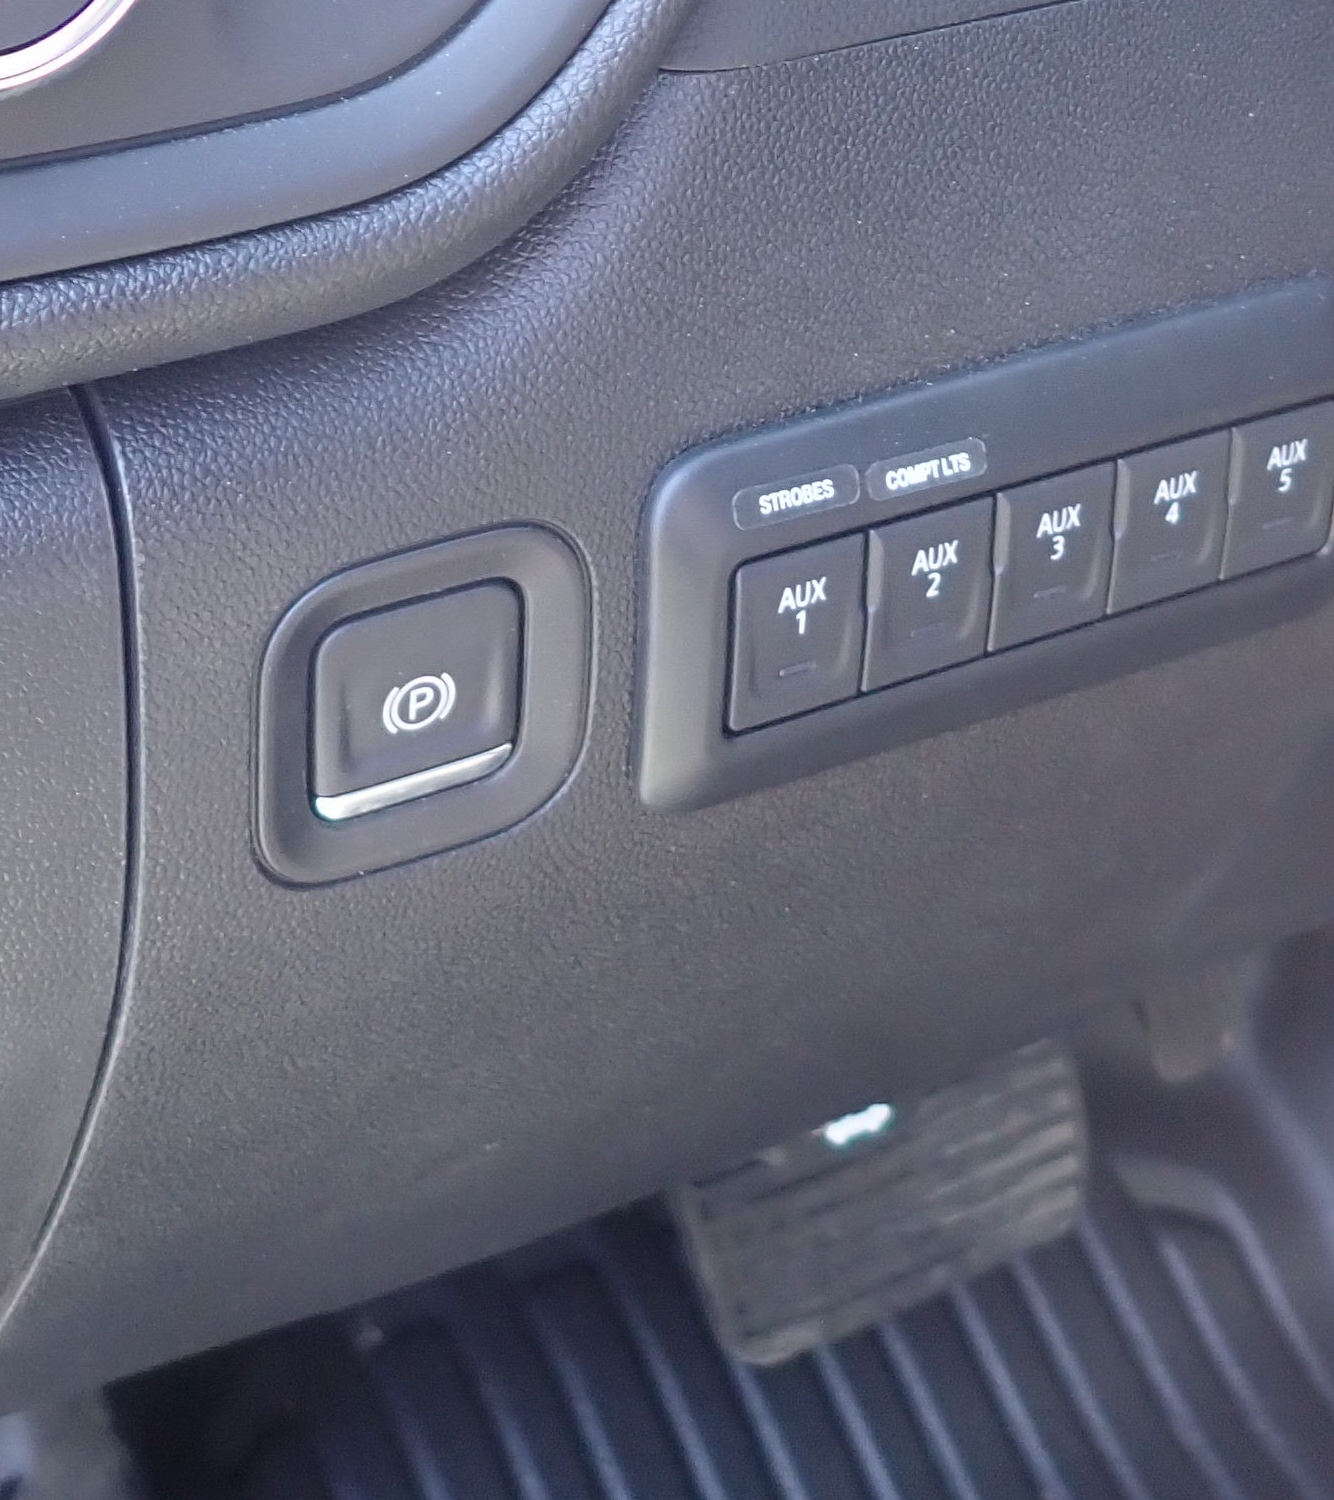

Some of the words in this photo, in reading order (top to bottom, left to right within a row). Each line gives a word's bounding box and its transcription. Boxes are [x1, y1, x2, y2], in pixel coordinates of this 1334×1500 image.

[885, 459, 941, 491] COMPT
[941, 452, 972, 476] LTS
[1267, 439, 1308, 471] AUX
[758, 478, 835, 515] STROBES
[1153, 470, 1199, 504] AUX
[1278, 468, 1292, 493] 5
[1036, 503, 1082, 538] AUX
[1165, 502, 1181, 525] 4
[911, 539, 959, 576] AUX
[1050, 535, 1065, 561] 3
[777, 576, 828, 614] AUX
[926, 572, 942, 598] 2
[795, 610, 807, 634] 1
